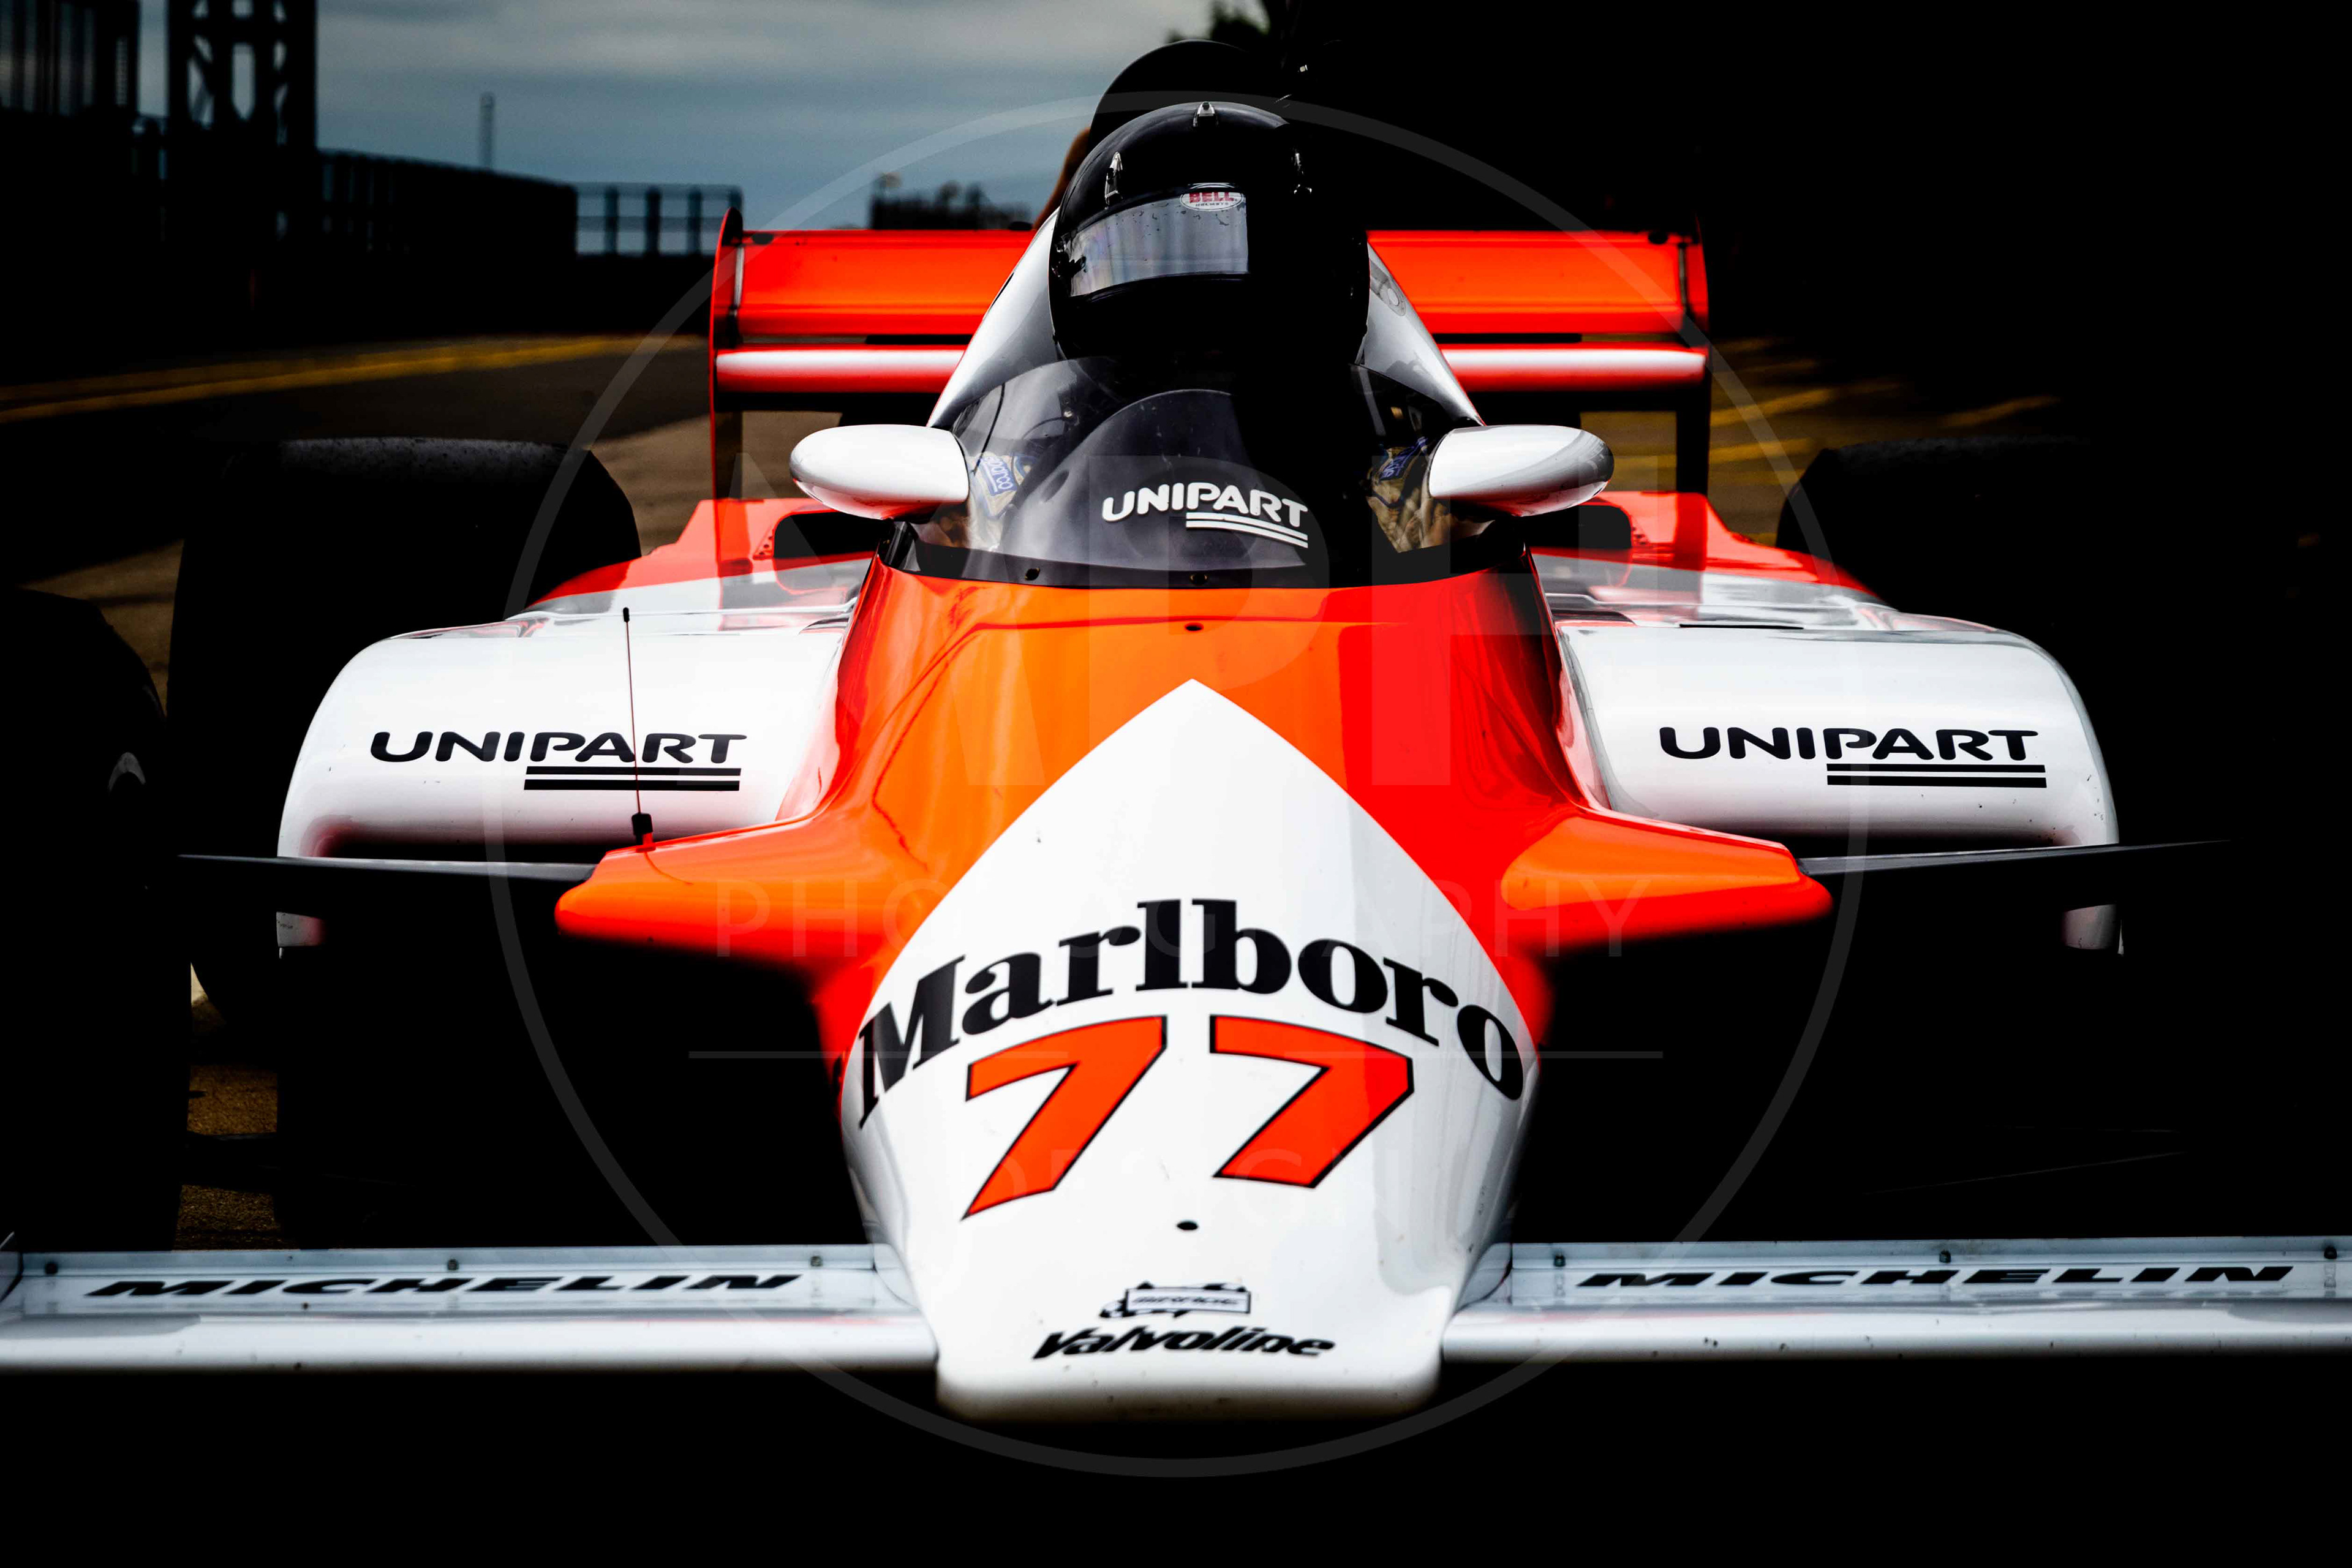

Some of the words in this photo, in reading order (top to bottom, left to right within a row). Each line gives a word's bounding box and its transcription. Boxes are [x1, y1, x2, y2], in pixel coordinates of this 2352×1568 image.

[1189, 191, 1234, 203] BELL
[1102, 481, 1308, 528] UNIPART
[371, 731, 747, 764] UNIPART
[1659, 726, 2038, 761] UNIPART
[859, 898, 1524, 1129] Marlboro
[961, 1014, 1415, 1221] 77
[85, 1273, 802, 1297] MICHELIN
[1575, 1266, 2294, 1288] MICHELIN
[1031, 1325, 1336, 1360] Valvoline
